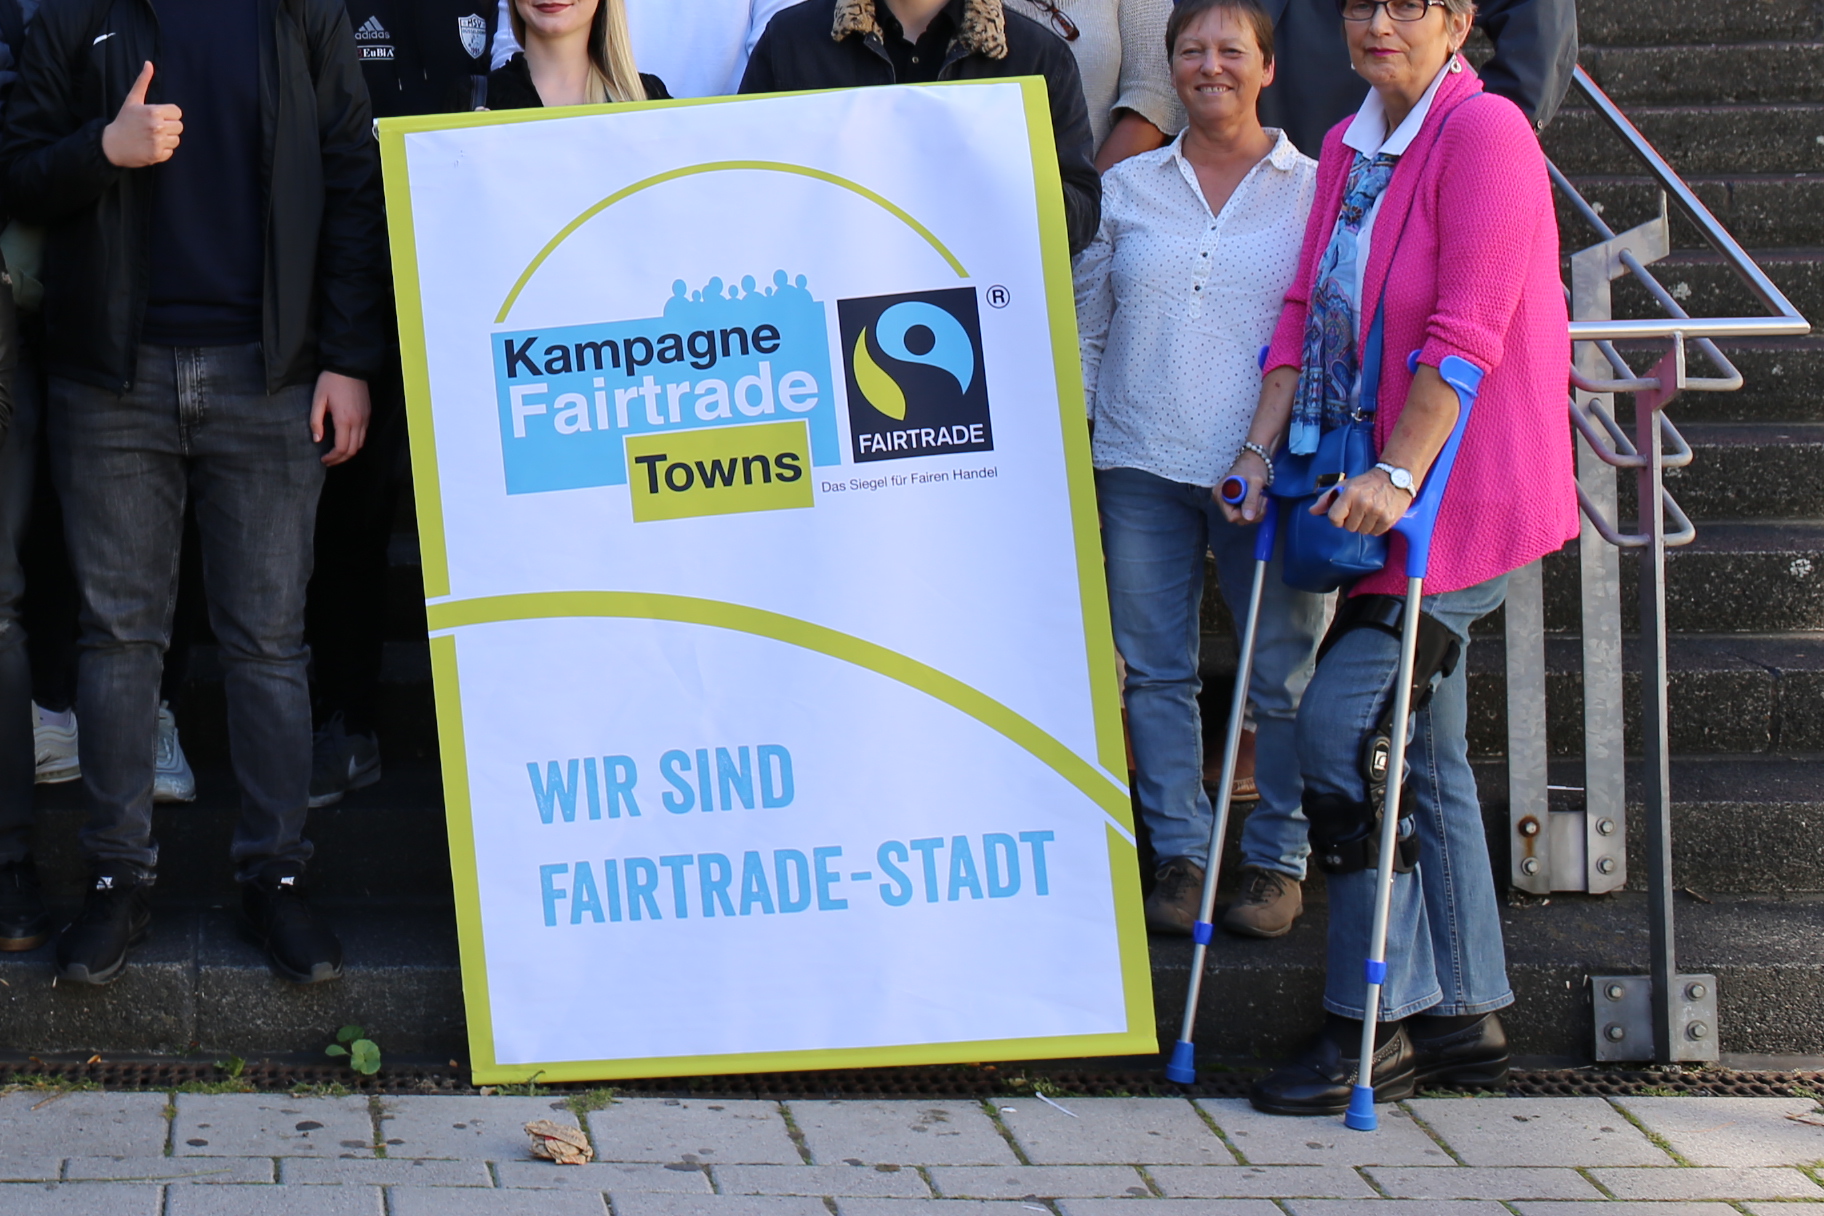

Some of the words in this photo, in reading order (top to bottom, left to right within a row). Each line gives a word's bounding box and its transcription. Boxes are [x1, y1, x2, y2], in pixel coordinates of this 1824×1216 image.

[355, 31, 390, 40] adidas
[504, 324, 781, 378] Kampagne
[509, 361, 819, 438] Fairtrade
[859, 424, 984, 454] FAIRTRADE
[634, 452, 803, 494] Towns
[821, 481, 846, 493] Das
[850, 475, 887, 491] Siegel
[892, 474, 907, 486] für
[911, 469, 949, 484] Fairen
[953, 466, 998, 480] Handel
[526, 755, 642, 825] WIR
[659, 744, 795, 815] SIND
[539, 830, 1056, 927] FAIRTRADE-STADT
